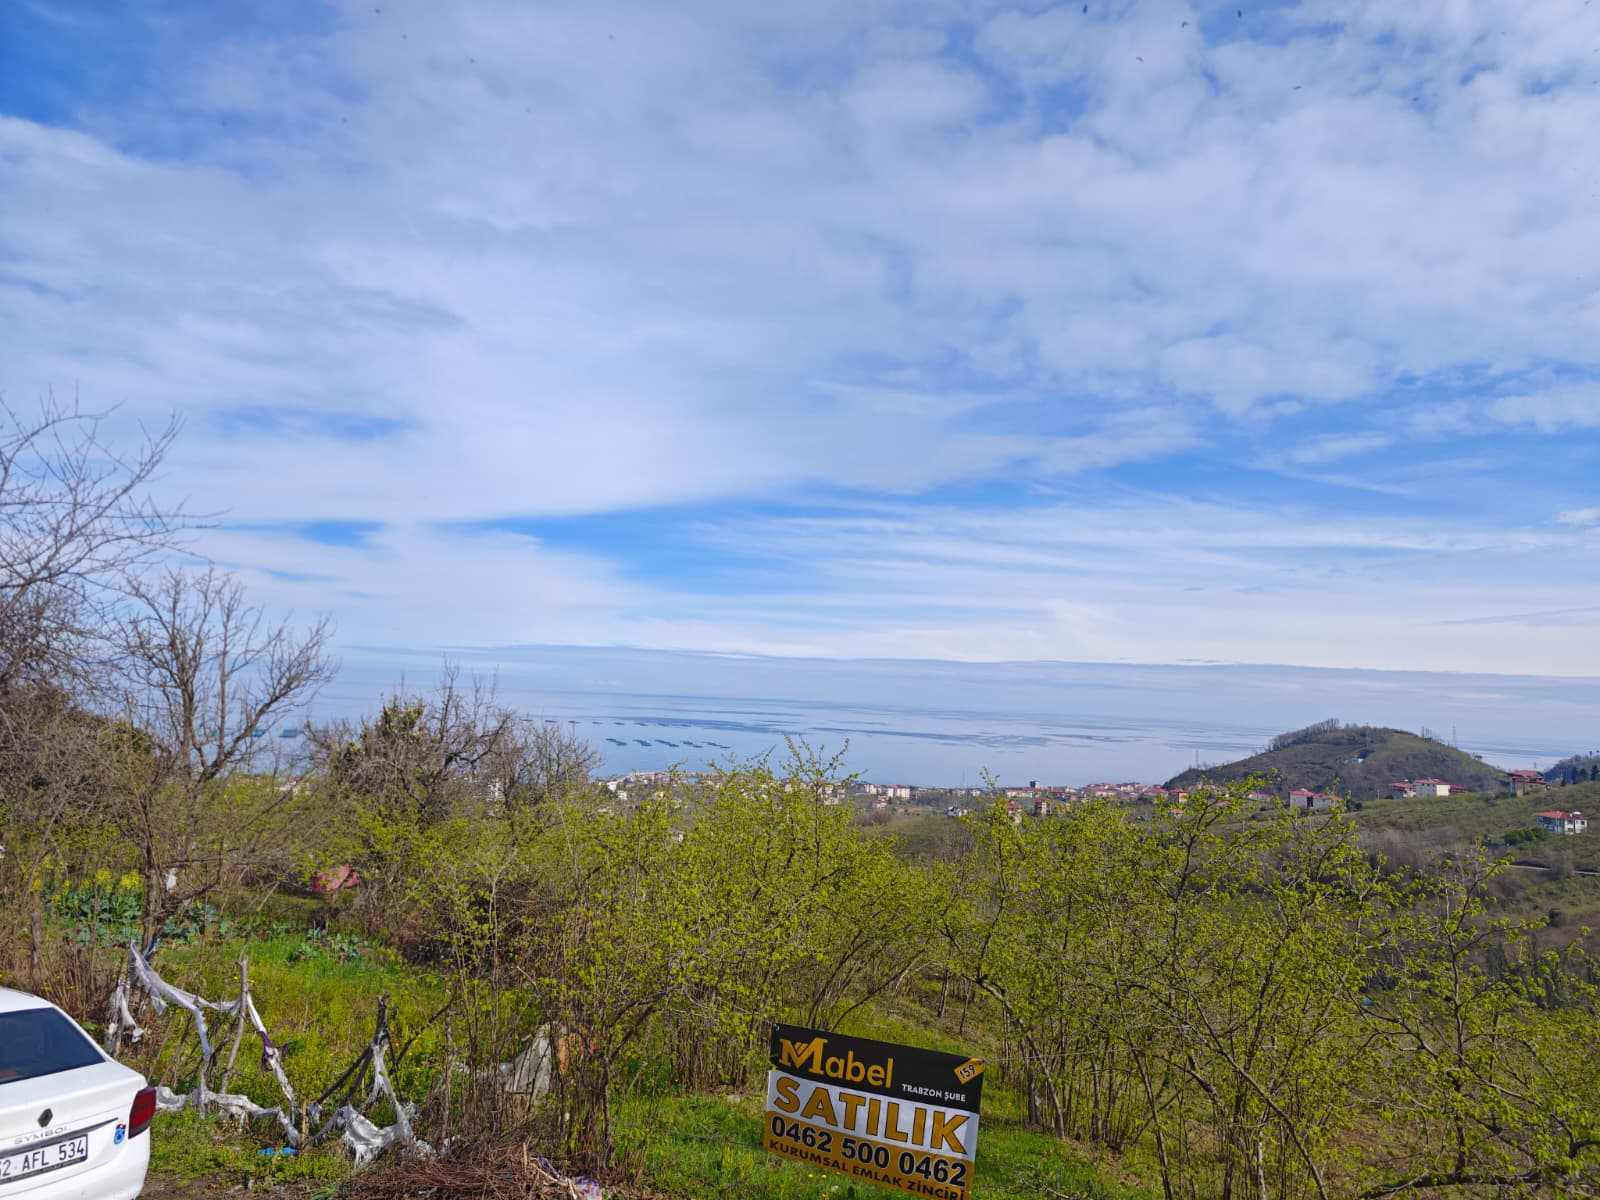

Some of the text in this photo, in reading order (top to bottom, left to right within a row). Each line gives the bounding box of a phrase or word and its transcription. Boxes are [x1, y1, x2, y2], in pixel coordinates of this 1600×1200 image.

[779, 1037, 894, 1089] Mabel
[960, 1064, 977, 1080] 159
[902, 1083, 967, 1102] TRABZON ŞUBE
[14, 1125, 70, 1145] SYMBOL
[774, 1076, 970, 1155] SATILIK
[0, 1139, 85, 1177] 2 AFL 534
[770, 1139, 848, 1173] KURUMSAL
[852, 1165, 902, 1188] EMLAK
[771, 1116, 967, 1187] 0462 500 0462
